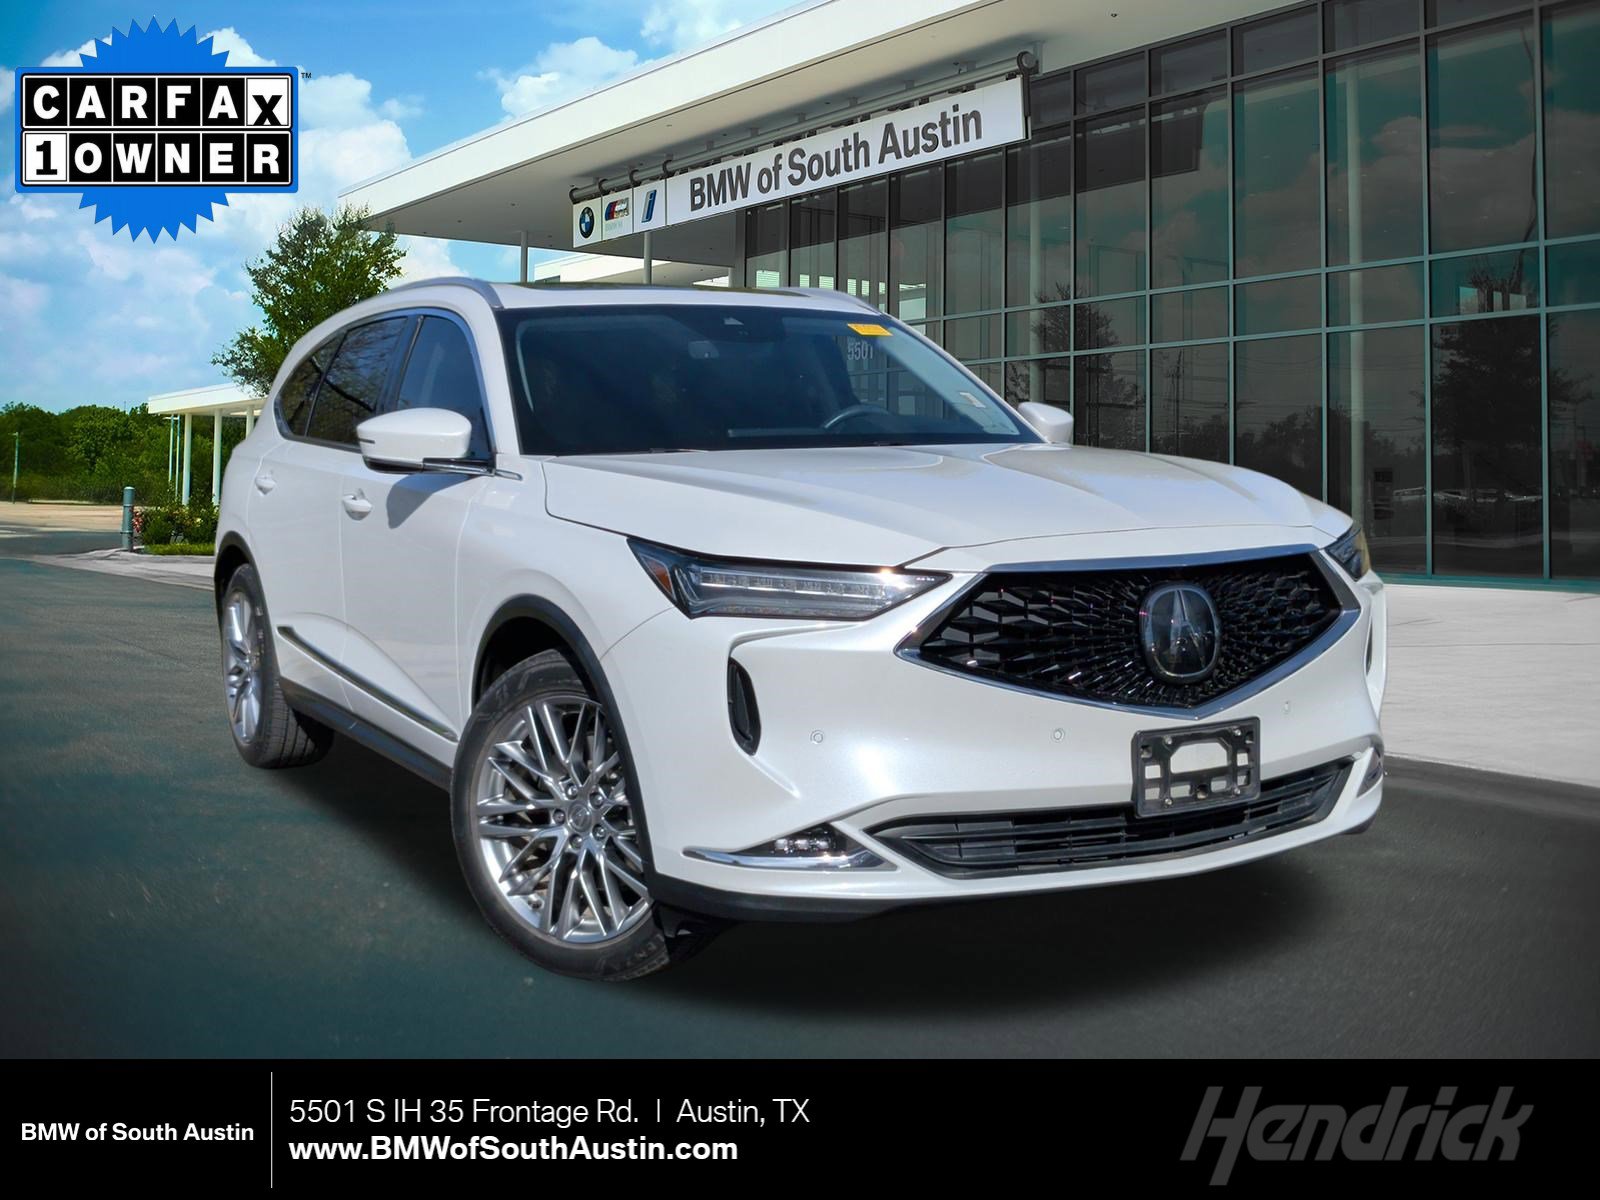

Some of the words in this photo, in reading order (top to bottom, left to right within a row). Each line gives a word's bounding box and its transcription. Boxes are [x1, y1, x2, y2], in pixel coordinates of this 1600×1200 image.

[690, 162, 752, 212] BMW
[757, 153, 783, 195] of
[787, 132, 871, 187] South
[878, 103, 983, 164] Austin
